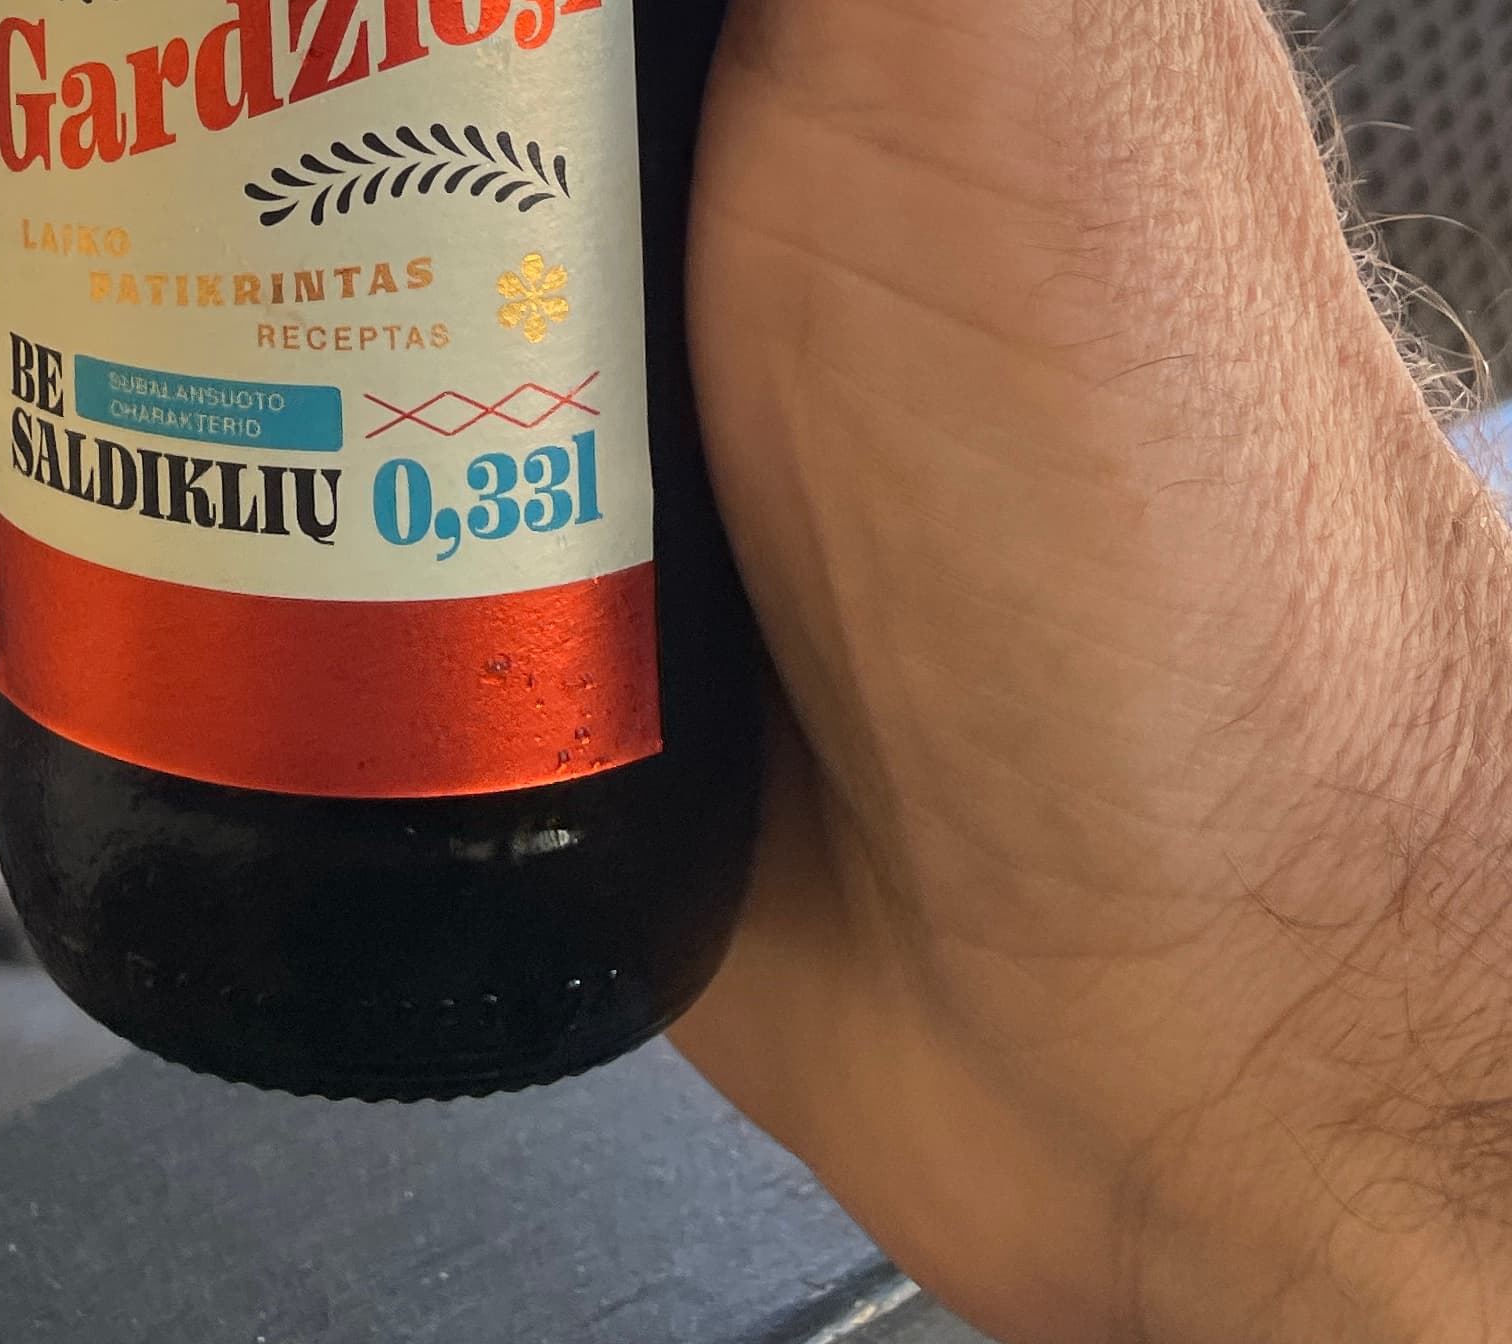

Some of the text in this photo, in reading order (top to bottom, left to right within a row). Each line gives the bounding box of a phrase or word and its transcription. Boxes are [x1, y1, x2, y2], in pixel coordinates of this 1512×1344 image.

[21, 218, 131, 257] LAIKO
[90, 256, 434, 307] PATIKRINTAS
[257, 322, 450, 351] RECEPTAS
[10, 331, 64, 417] BE
[11, 407, 342, 546] SALDIKLIŲ
[373, 430, 603, 562] 0,33l
